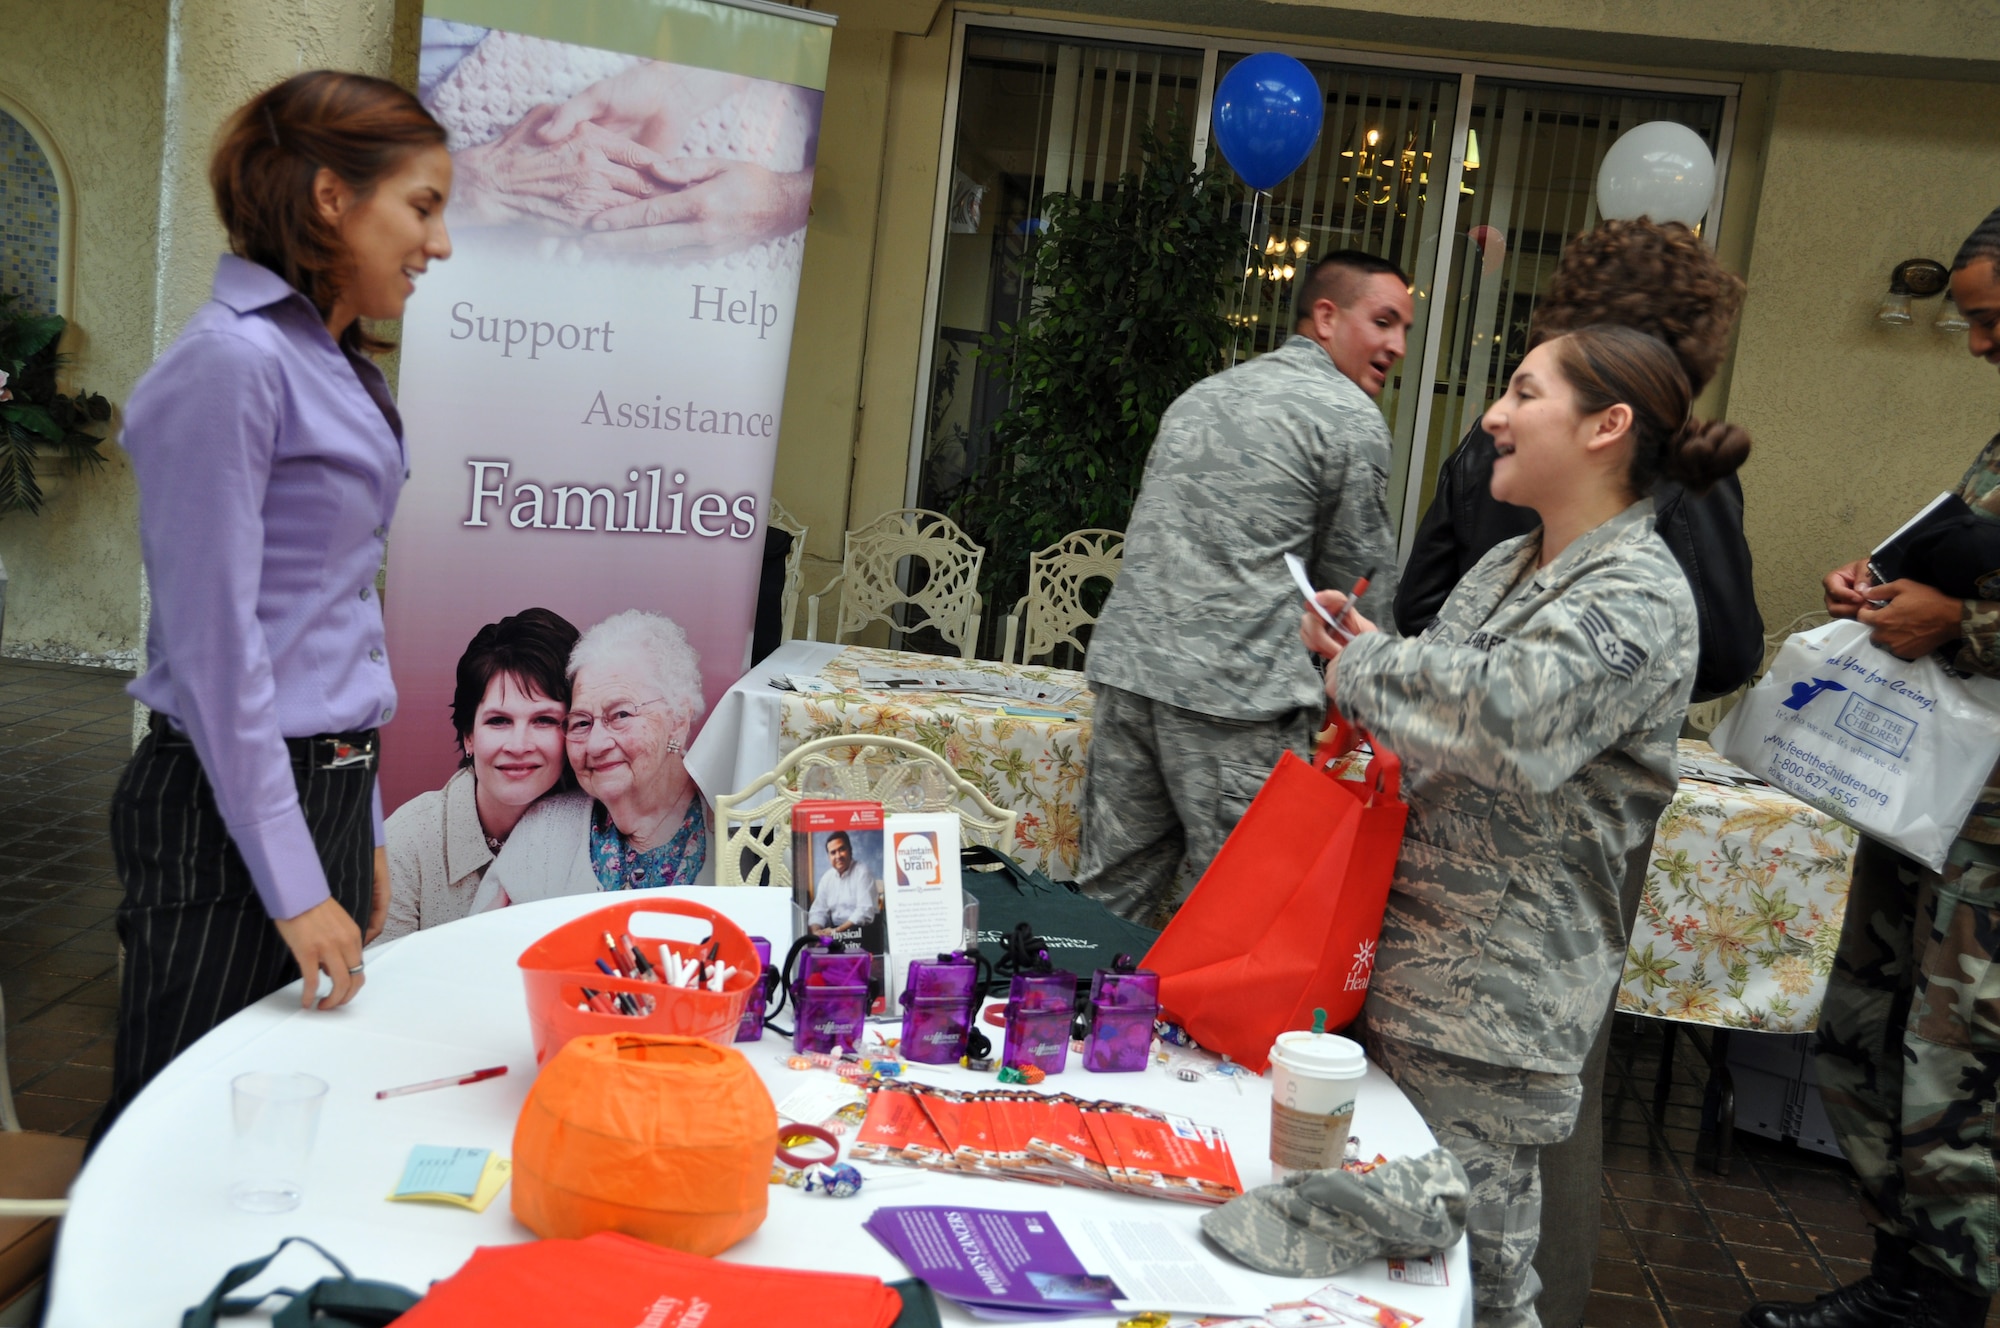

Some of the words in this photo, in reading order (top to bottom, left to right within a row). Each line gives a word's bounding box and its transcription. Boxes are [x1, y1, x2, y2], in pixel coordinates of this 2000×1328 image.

[449, 301, 615, 360] Support
[689, 283, 779, 340] Help
[580, 389, 774, 438] Assistance
[463, 460, 757, 540] Families
[1842, 656, 1867, 675] You
[1864, 669, 1888, 687] for
[1889, 681, 1938, 712] Caring!
[1775, 710, 1788, 721] It's
[1807, 721, 1819, 732] we
[1820, 729, 1834, 741] are.
[1837, 737, 1848, 750] It's
[1850, 745, 1872, 762] what
[1874, 757, 1888, 769] we
[1888, 762, 1902, 777] do.
[1844, 713, 1901, 746] CHILDREN
[1852, 701, 1880, 723] FEED
[1882, 718, 1905, 735] THE
[1772, 753, 1859, 808] 1-800-627-4556
[898, 847, 933, 856] maintain
[903, 859, 933, 872] brain
